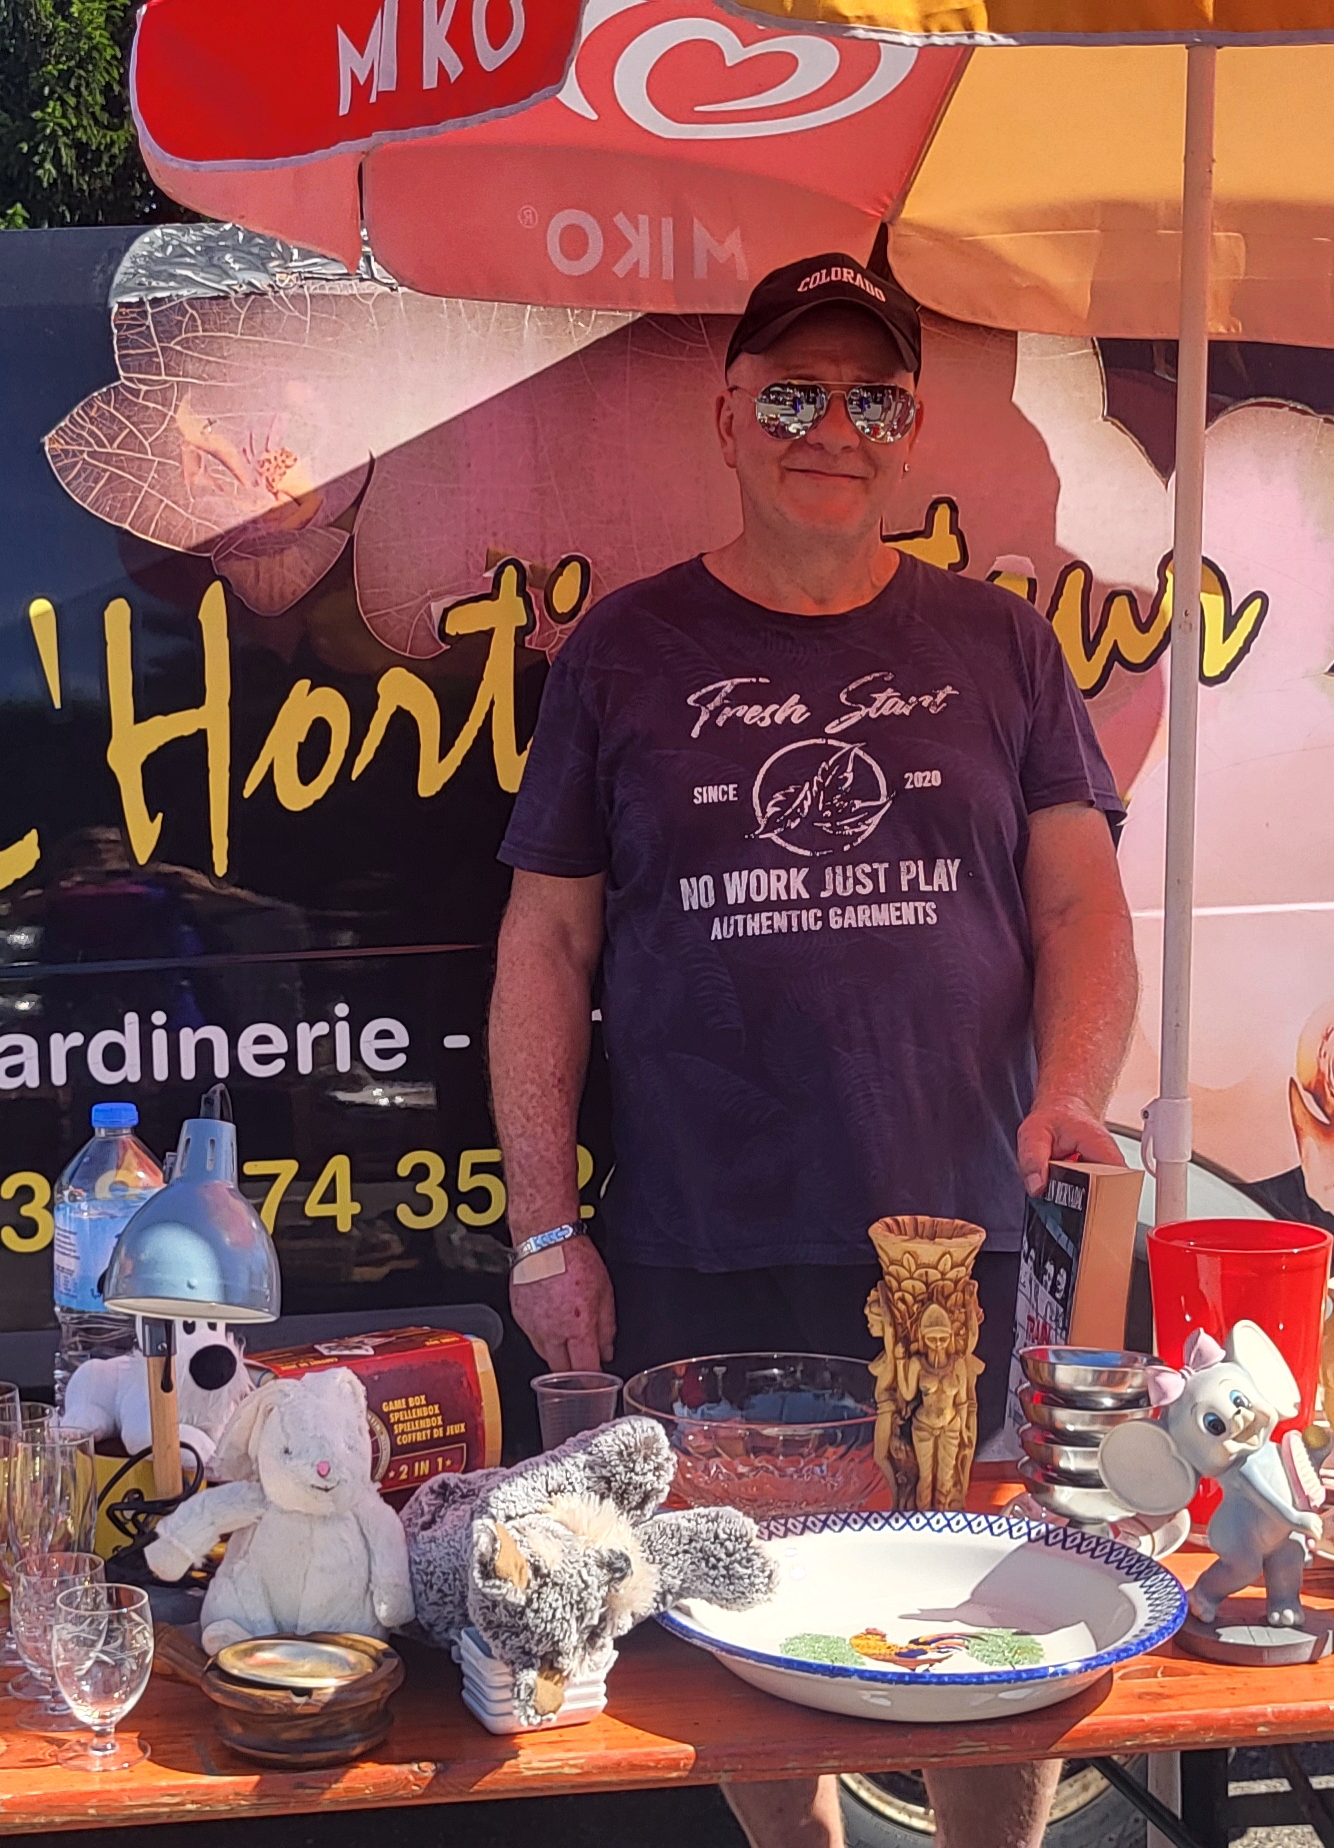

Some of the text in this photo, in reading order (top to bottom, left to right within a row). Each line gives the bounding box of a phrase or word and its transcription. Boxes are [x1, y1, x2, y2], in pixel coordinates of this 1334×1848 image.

[336, 0, 526, 117] MIKO
[796, 266, 887, 303] COLORADO
[685, 671, 960, 739] Fresh Start
[692, 770, 943, 806] SINCE 2020
[679, 858, 962, 912] NO WORK JUST PLAY
[709, 901, 939, 942] AUTHENTIC GARMENTS
[242, 1152, 363, 1235] 74
[394, 1148, 509, 1232] 35
[381, 1393, 427, 1413] GAME BOX
[389, 1403, 441, 1424] SPELLENBOX
[393, 1414, 444, 1435] SPIELENBOX
[396, 1422, 467, 1446] COFFRET DE JEUX
[398, 1456, 444, 1481] 2 IN 1
